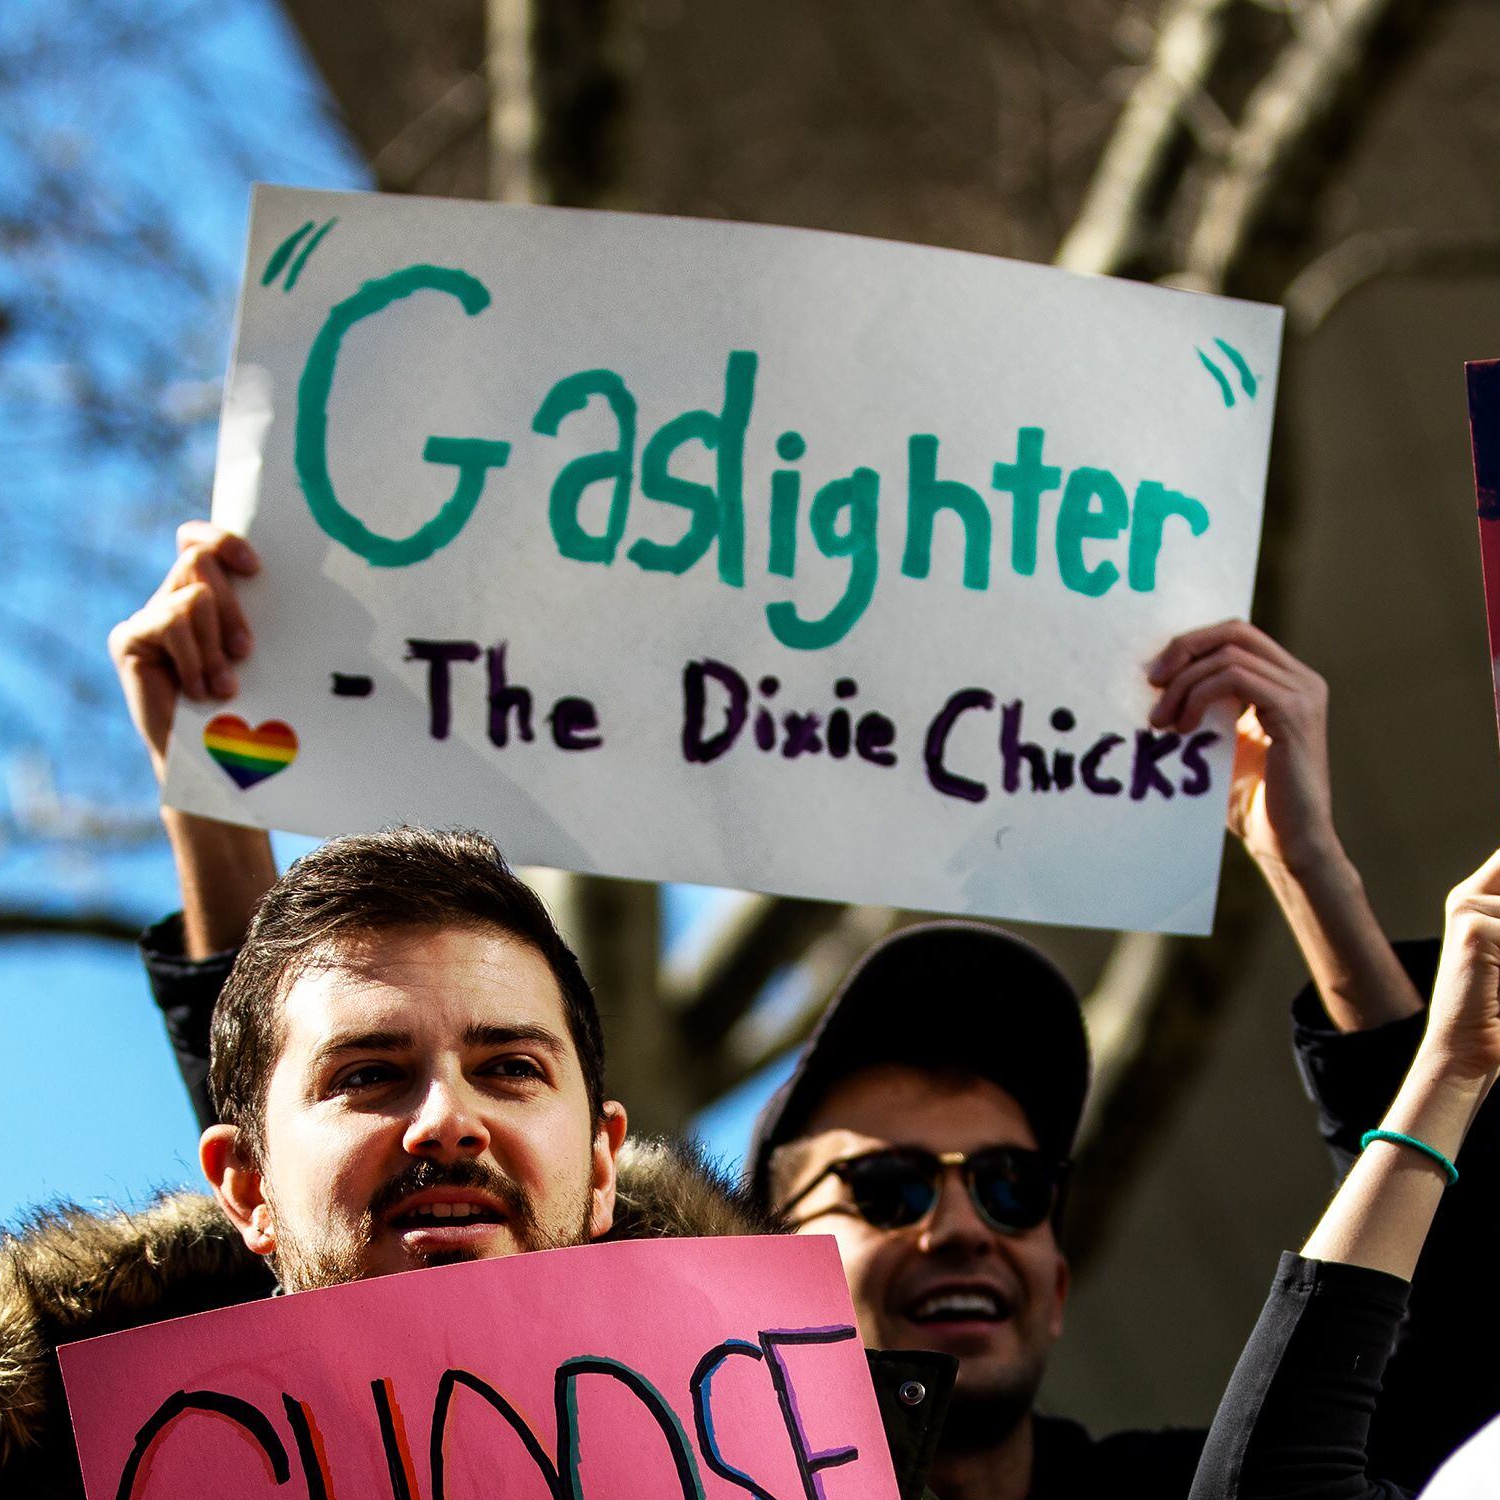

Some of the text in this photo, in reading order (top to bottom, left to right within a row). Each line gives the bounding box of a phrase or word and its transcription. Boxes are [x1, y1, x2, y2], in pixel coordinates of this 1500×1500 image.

[406, 637, 603, 753] The
[681, 659, 898, 768] Dixie
[924, 687, 1222, 803] Chicks
